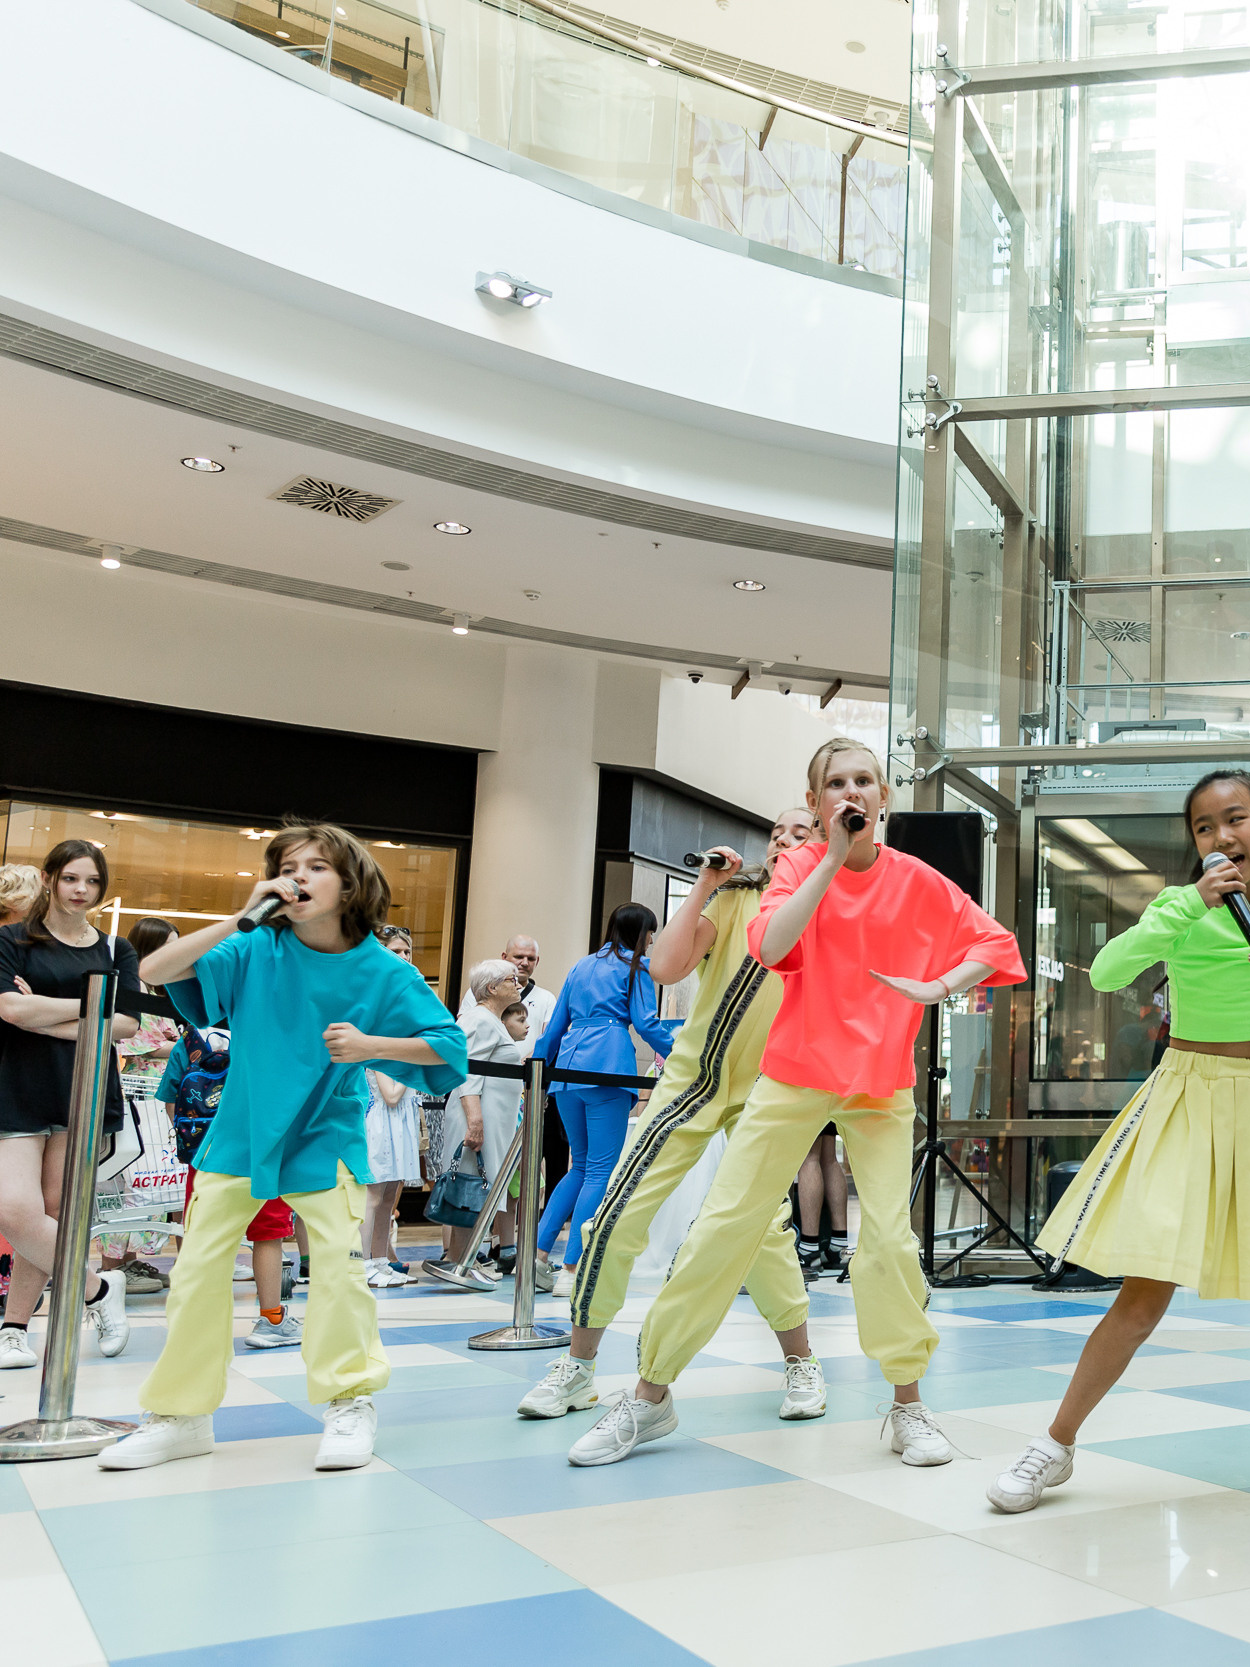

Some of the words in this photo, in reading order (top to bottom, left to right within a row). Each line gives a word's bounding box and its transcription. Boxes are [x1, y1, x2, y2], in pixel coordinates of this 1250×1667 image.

[742, 990, 754, 1011] LOVE
[656, 1105, 674, 1119] LOVE
[683, 1103, 700, 1121] LOVE
[639, 1126, 653, 1144] LOVE
[662, 1120, 680, 1136] LOVE
[1111, 1126, 1131, 1153] WANG
[623, 1151, 636, 1168] LOVE
[646, 1142, 661, 1161] LOVE
[132, 1172, 187, 1188] АСТРАТ
[629, 1167, 646, 1187] LOVE
[1095, 1160, 1111, 1183] TIME
[614, 1191, 630, 1213] LOVE
[1077, 1193, 1094, 1222] WANG
[601, 1218, 614, 1245] LOVE
[1061, 1232, 1077, 1254] TIME
[586, 1269, 598, 1288] LOVE
